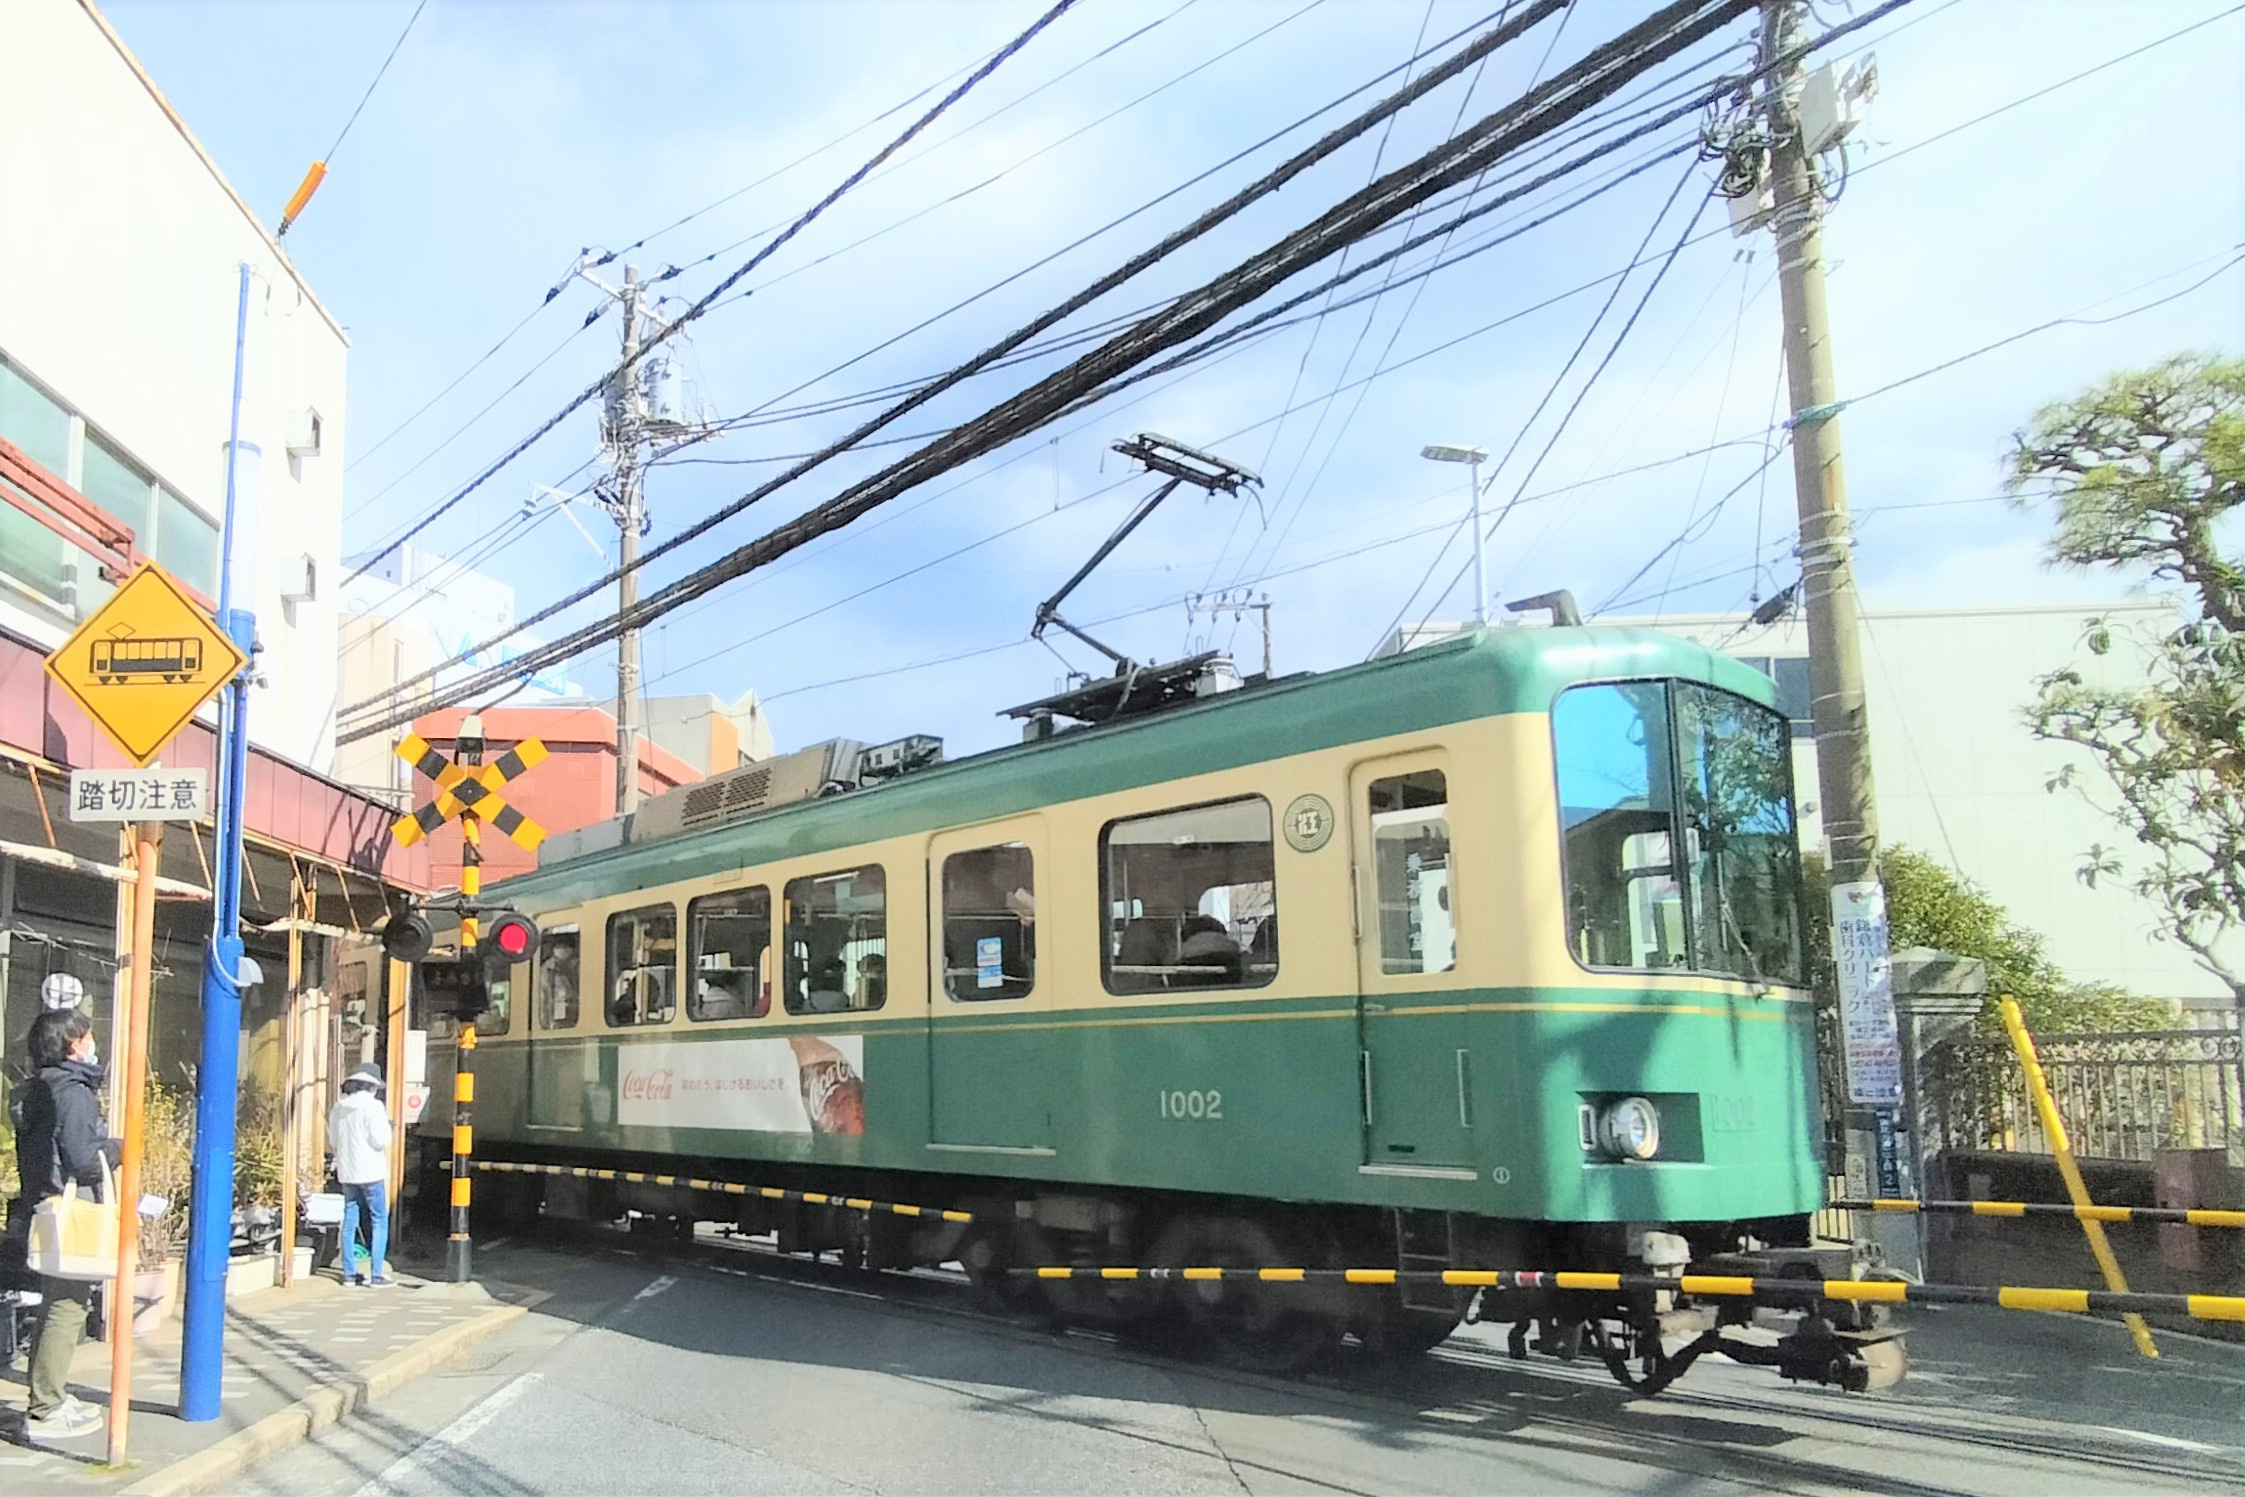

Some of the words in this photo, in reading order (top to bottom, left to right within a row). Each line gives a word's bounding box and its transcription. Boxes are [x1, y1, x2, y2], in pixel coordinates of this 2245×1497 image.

[77, 779, 198, 811] 踏切注意
[1840, 920, 1860, 1013] 歯科クリニック
[1160, 1090, 1222, 1119] 1002
